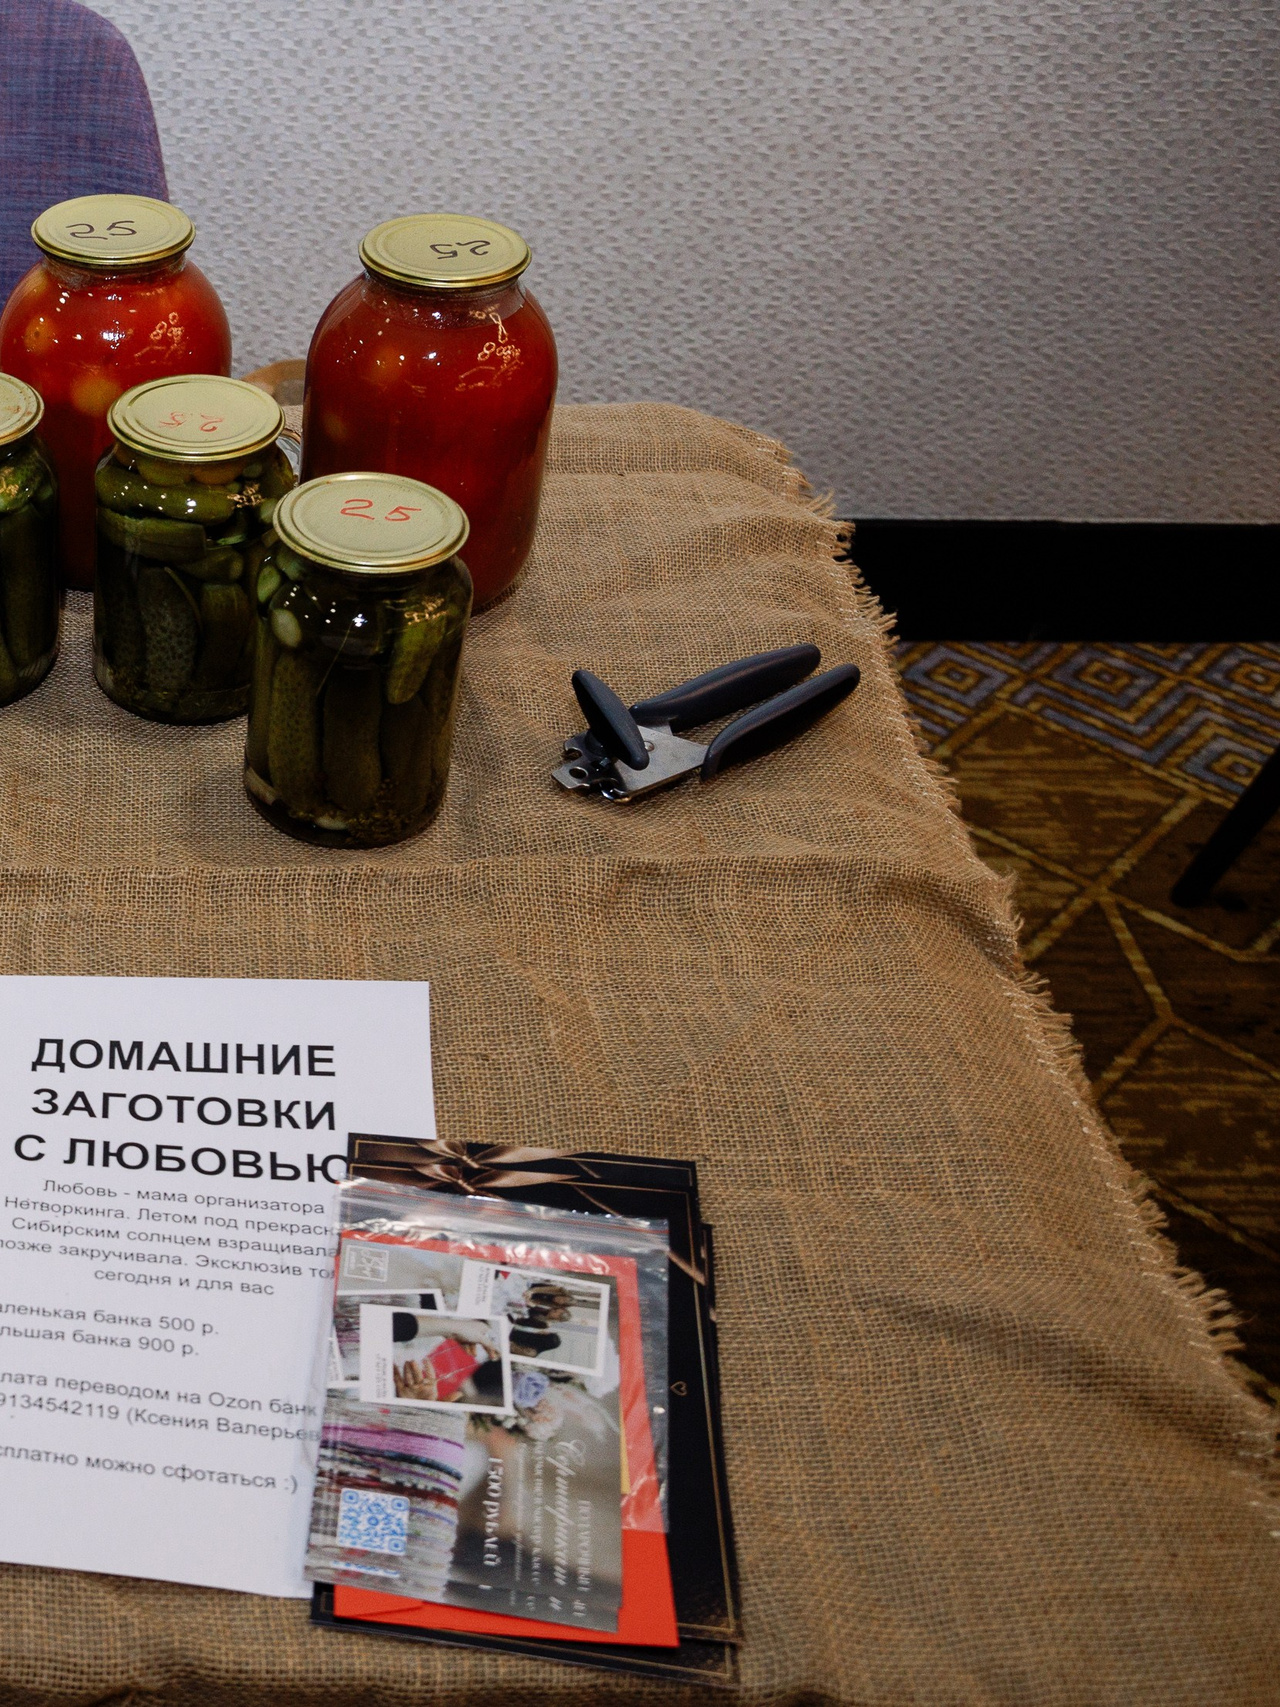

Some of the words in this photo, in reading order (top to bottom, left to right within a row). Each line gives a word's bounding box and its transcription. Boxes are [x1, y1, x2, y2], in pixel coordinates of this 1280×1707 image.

[65, 220, 138, 239] 25
[429, 240, 491, 259] 25
[340, 499, 422, 521] 25
[30, 1037, 336, 1077] ДОМАШНИЕ
[30, 1088, 336, 1131] ЗАГОТОВКИ
[13, 1134, 46, 1162] С
[62, 1137, 347, 1186] ЛЮБОВЬЮ
[42, 1178, 118, 1199] Любовь
[136, 1190, 188, 1203] мама
[193, 1193, 325, 1216] организатора
[4, 1196, 130, 1220] Нетворкинга.
[136, 1208, 197, 1225] Летом
[204, 1216, 239, 1231] под
[11, 1217, 120, 1239] Сибирским
[126, 1231, 211, 1248] солнцем
[58, 1245, 188, 1266] закручивала.
[195, 1254, 303, 1276] Эксклюзив
[93, 1270, 172, 1287] сегодня
[178, 1277, 191, 1288] и
[195, 1279, 233, 1292] для
[239, 1282, 275, 1296] вас
[93, 1309, 152, 1328] банка
[158, 1316, 195, 1333] 500
[201, 1322, 219, 1337] р.
[72, 1329, 132, 1349] банка
[137, 1336, 175, 1353] 900
[181, 1343, 199, 1358] р.
[54, 1376, 170, 1402] переводом
[176, 1391, 202, 1405] на
[207, 1391, 262, 1412] Ozon
[269, 1398, 317, 1418] банк
[126, 1406, 209, 1431] (Ксения
[84, 1456, 156, 1476] можно
[161, 1463, 277, 1489] сфотаться
[487, 1457, 504, 1497] 1500
